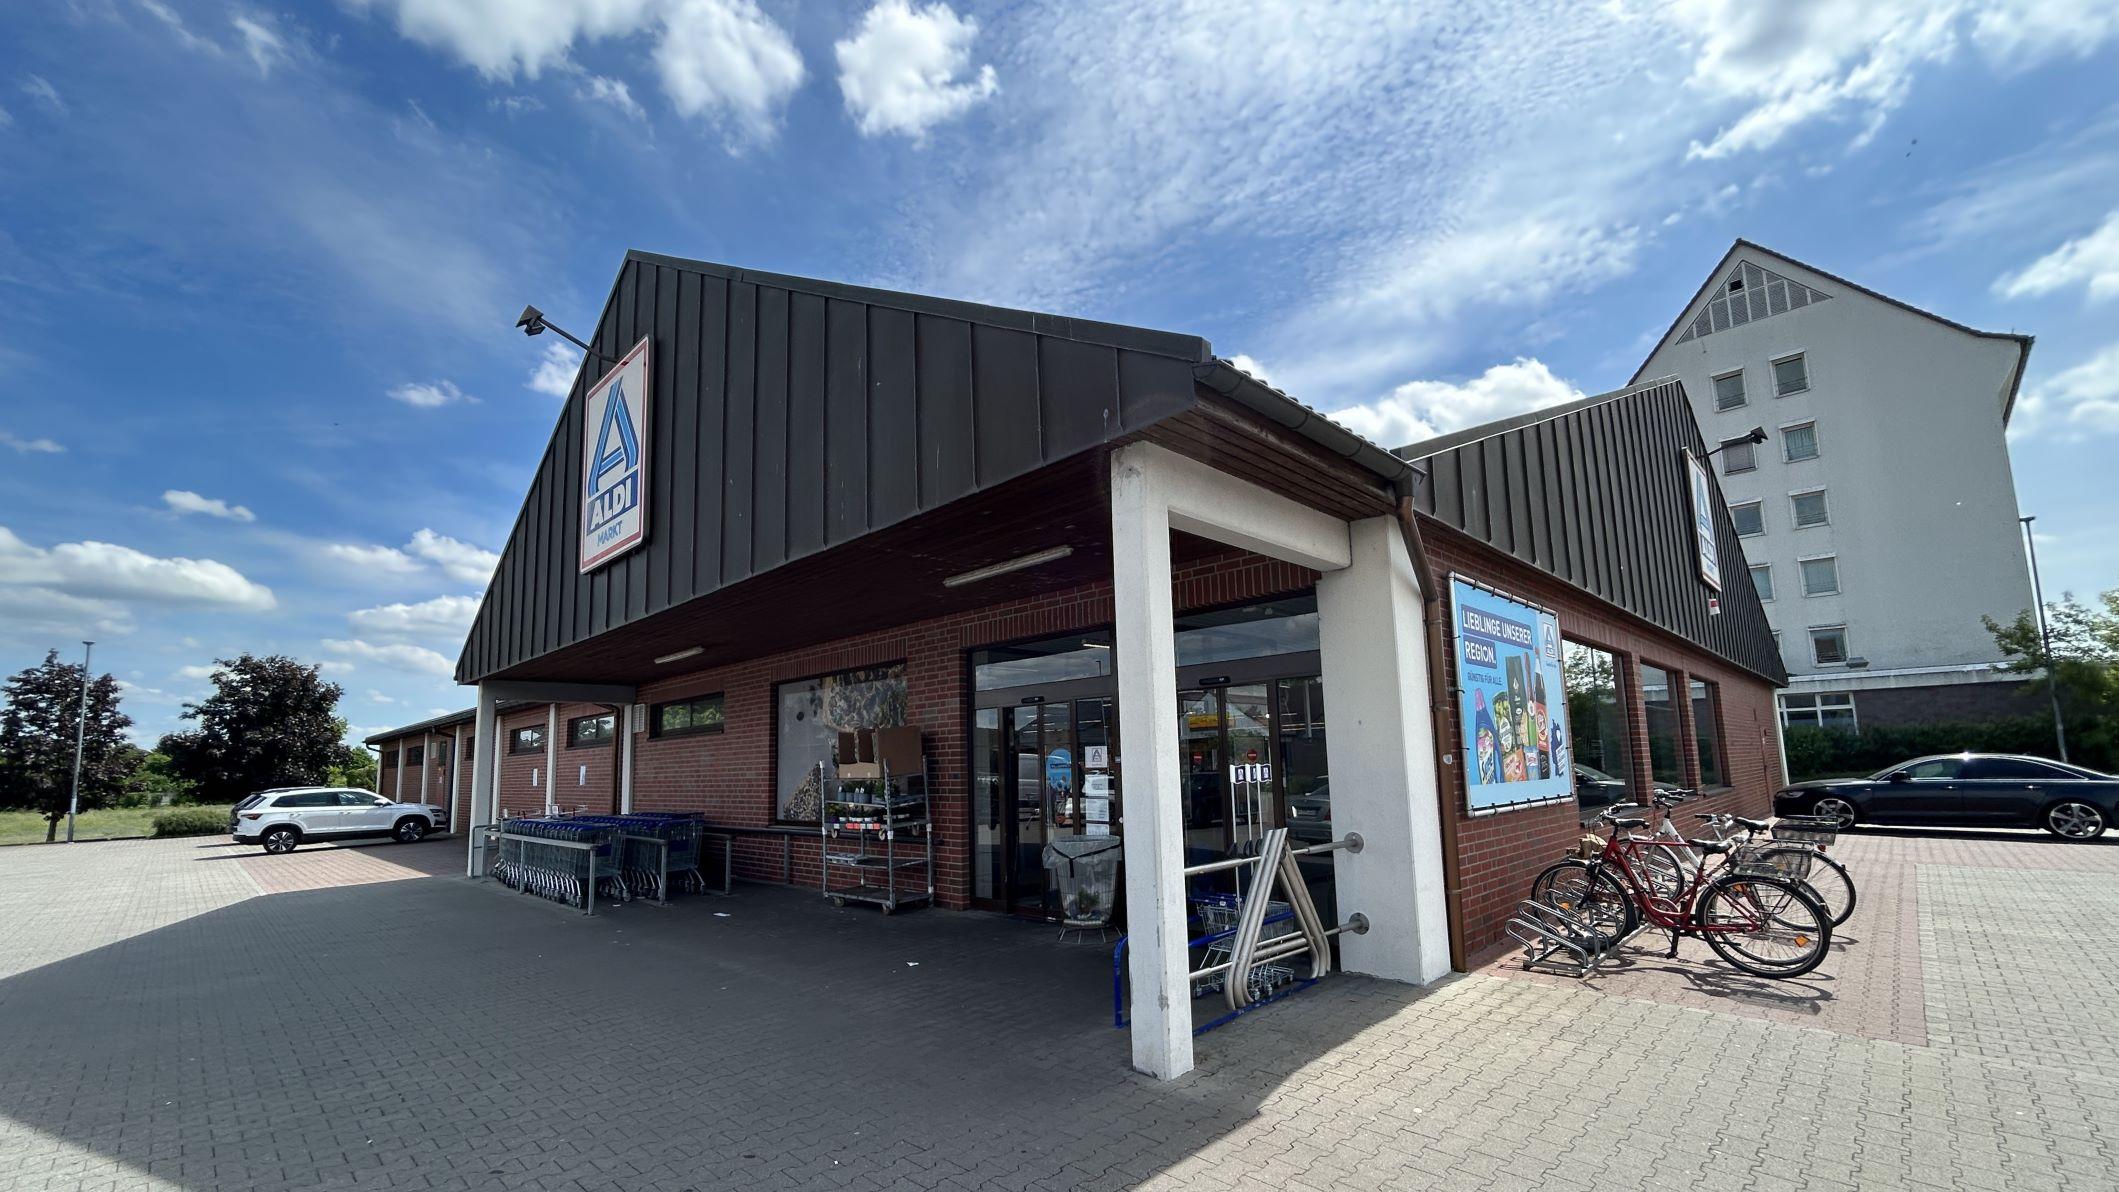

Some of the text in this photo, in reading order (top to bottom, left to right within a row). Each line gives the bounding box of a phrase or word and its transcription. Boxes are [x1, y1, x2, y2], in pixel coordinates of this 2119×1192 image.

[590, 477, 632, 530] ALDI
[597, 519, 623, 547] MARKT
[1462, 609, 1532, 645] LIEBLINGE UNSERER
[1464, 641, 1496, 664] REGION.
